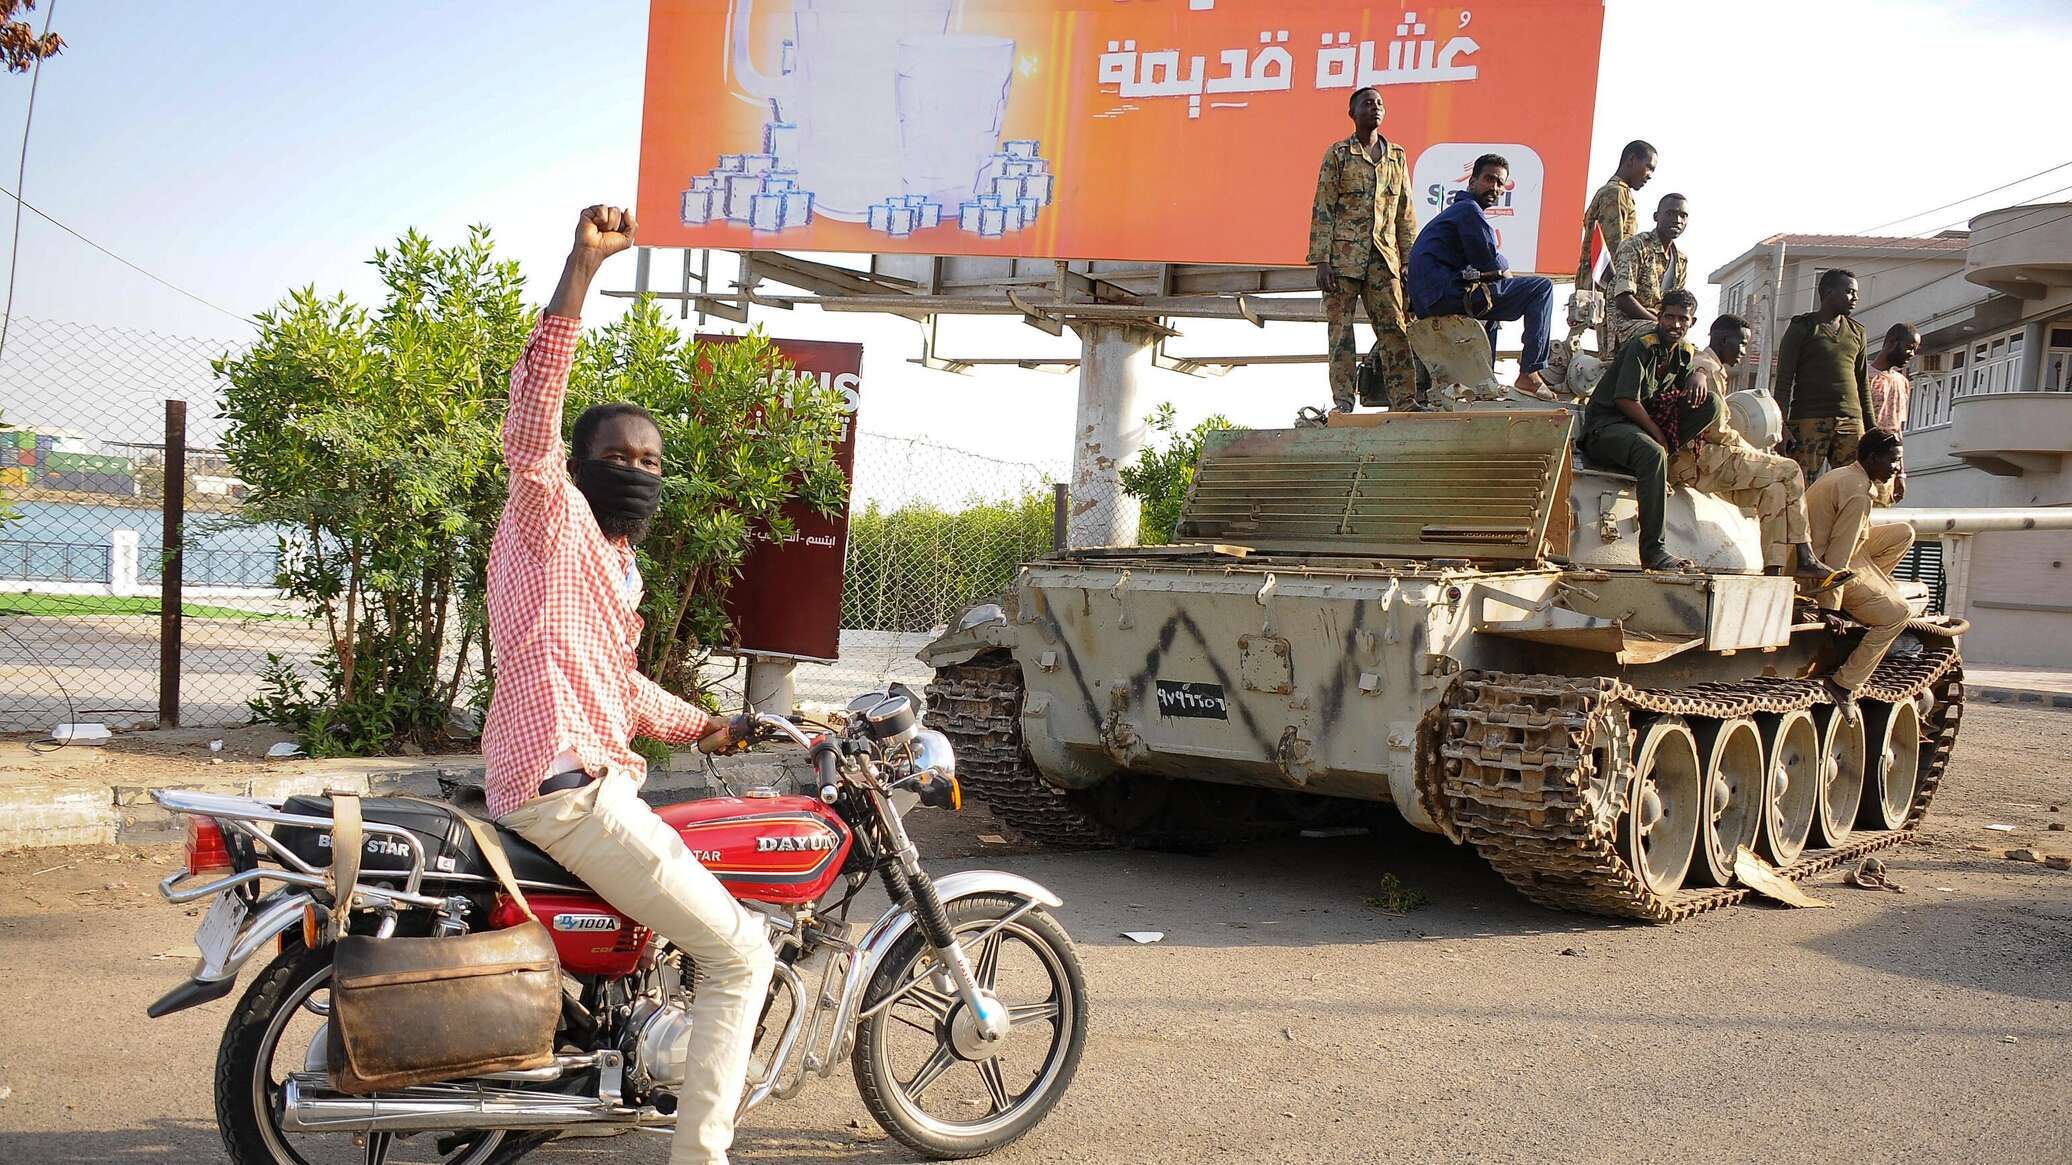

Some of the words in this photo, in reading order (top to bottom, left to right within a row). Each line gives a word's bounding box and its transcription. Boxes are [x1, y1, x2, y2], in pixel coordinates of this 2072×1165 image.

[1099, 30, 1293, 118] قديمة
[367, 840, 410, 857] STAR
[757, 834, 836, 852] DAYUN
[693, 850, 721, 862] TAR
